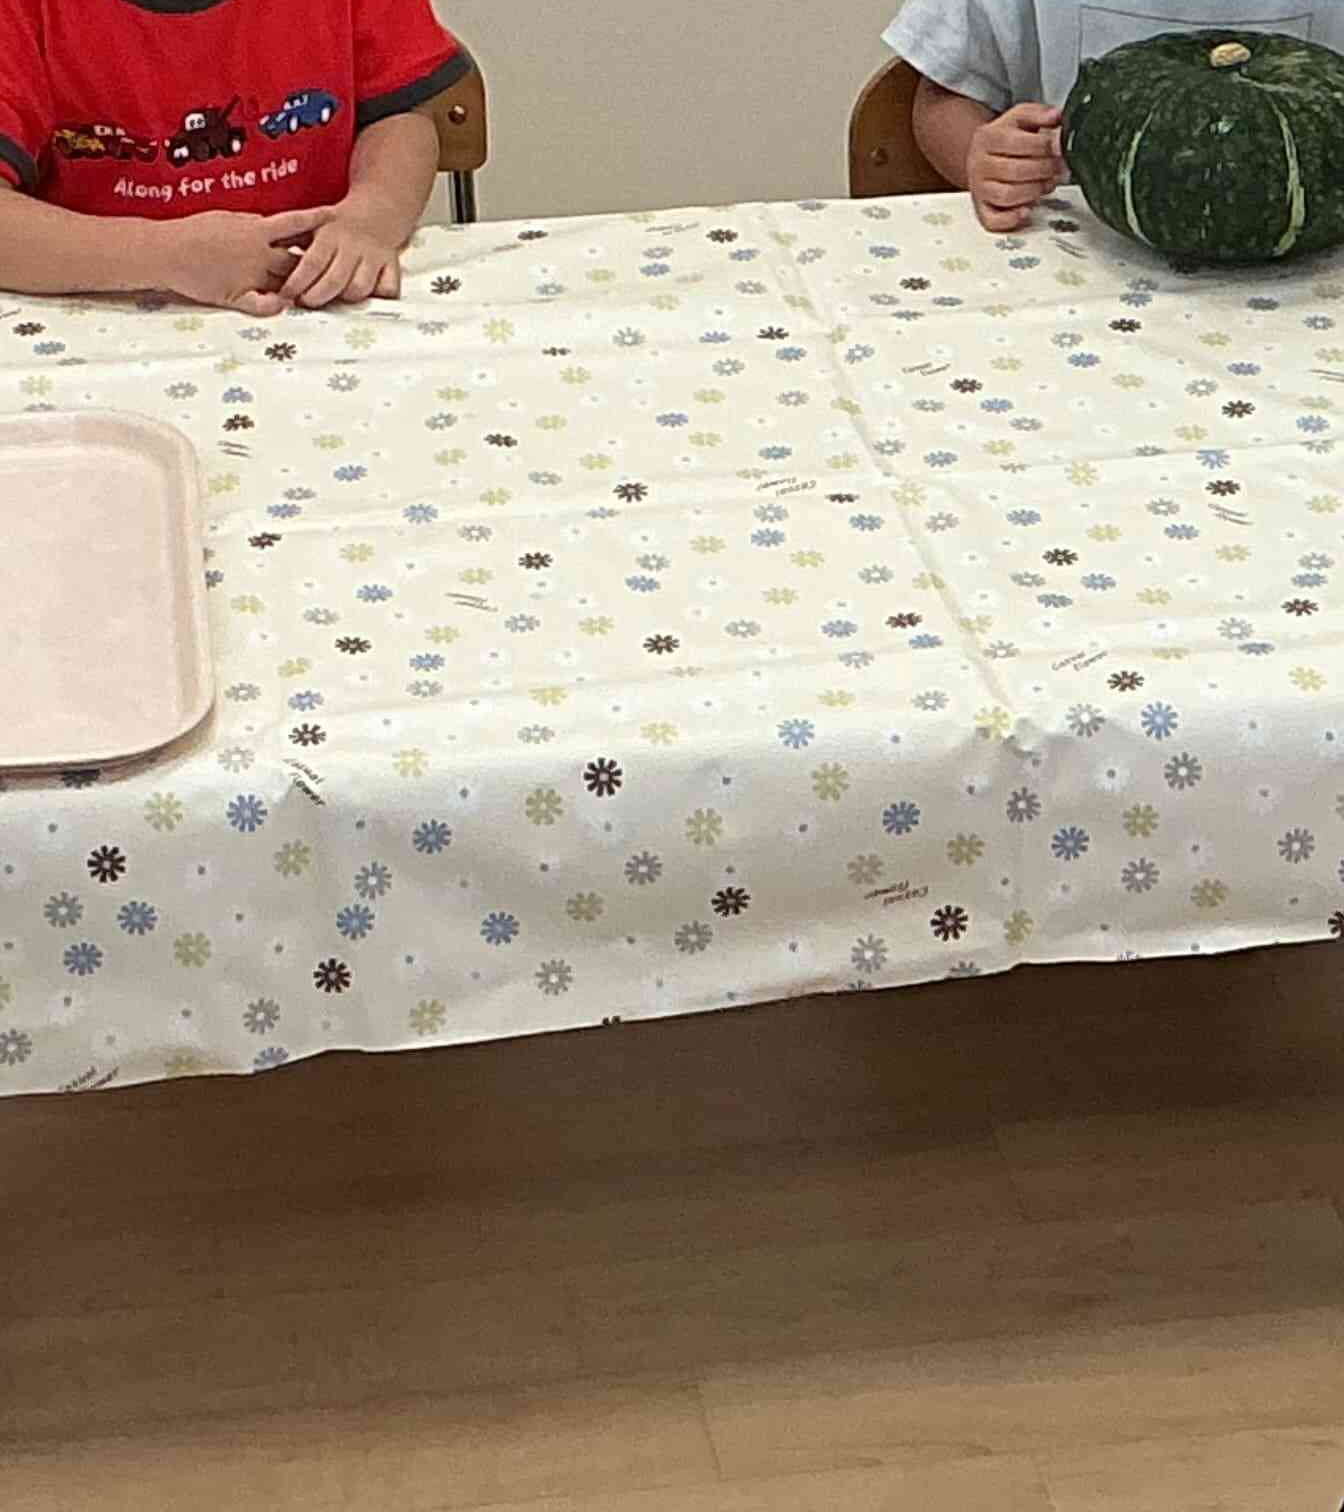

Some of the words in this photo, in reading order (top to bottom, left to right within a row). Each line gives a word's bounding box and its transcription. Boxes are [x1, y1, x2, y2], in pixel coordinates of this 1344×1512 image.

[113, 176, 173, 203] Along
[177, 176, 215, 197] for
[221, 169, 256, 189] the
[261, 158, 298, 184] ride
